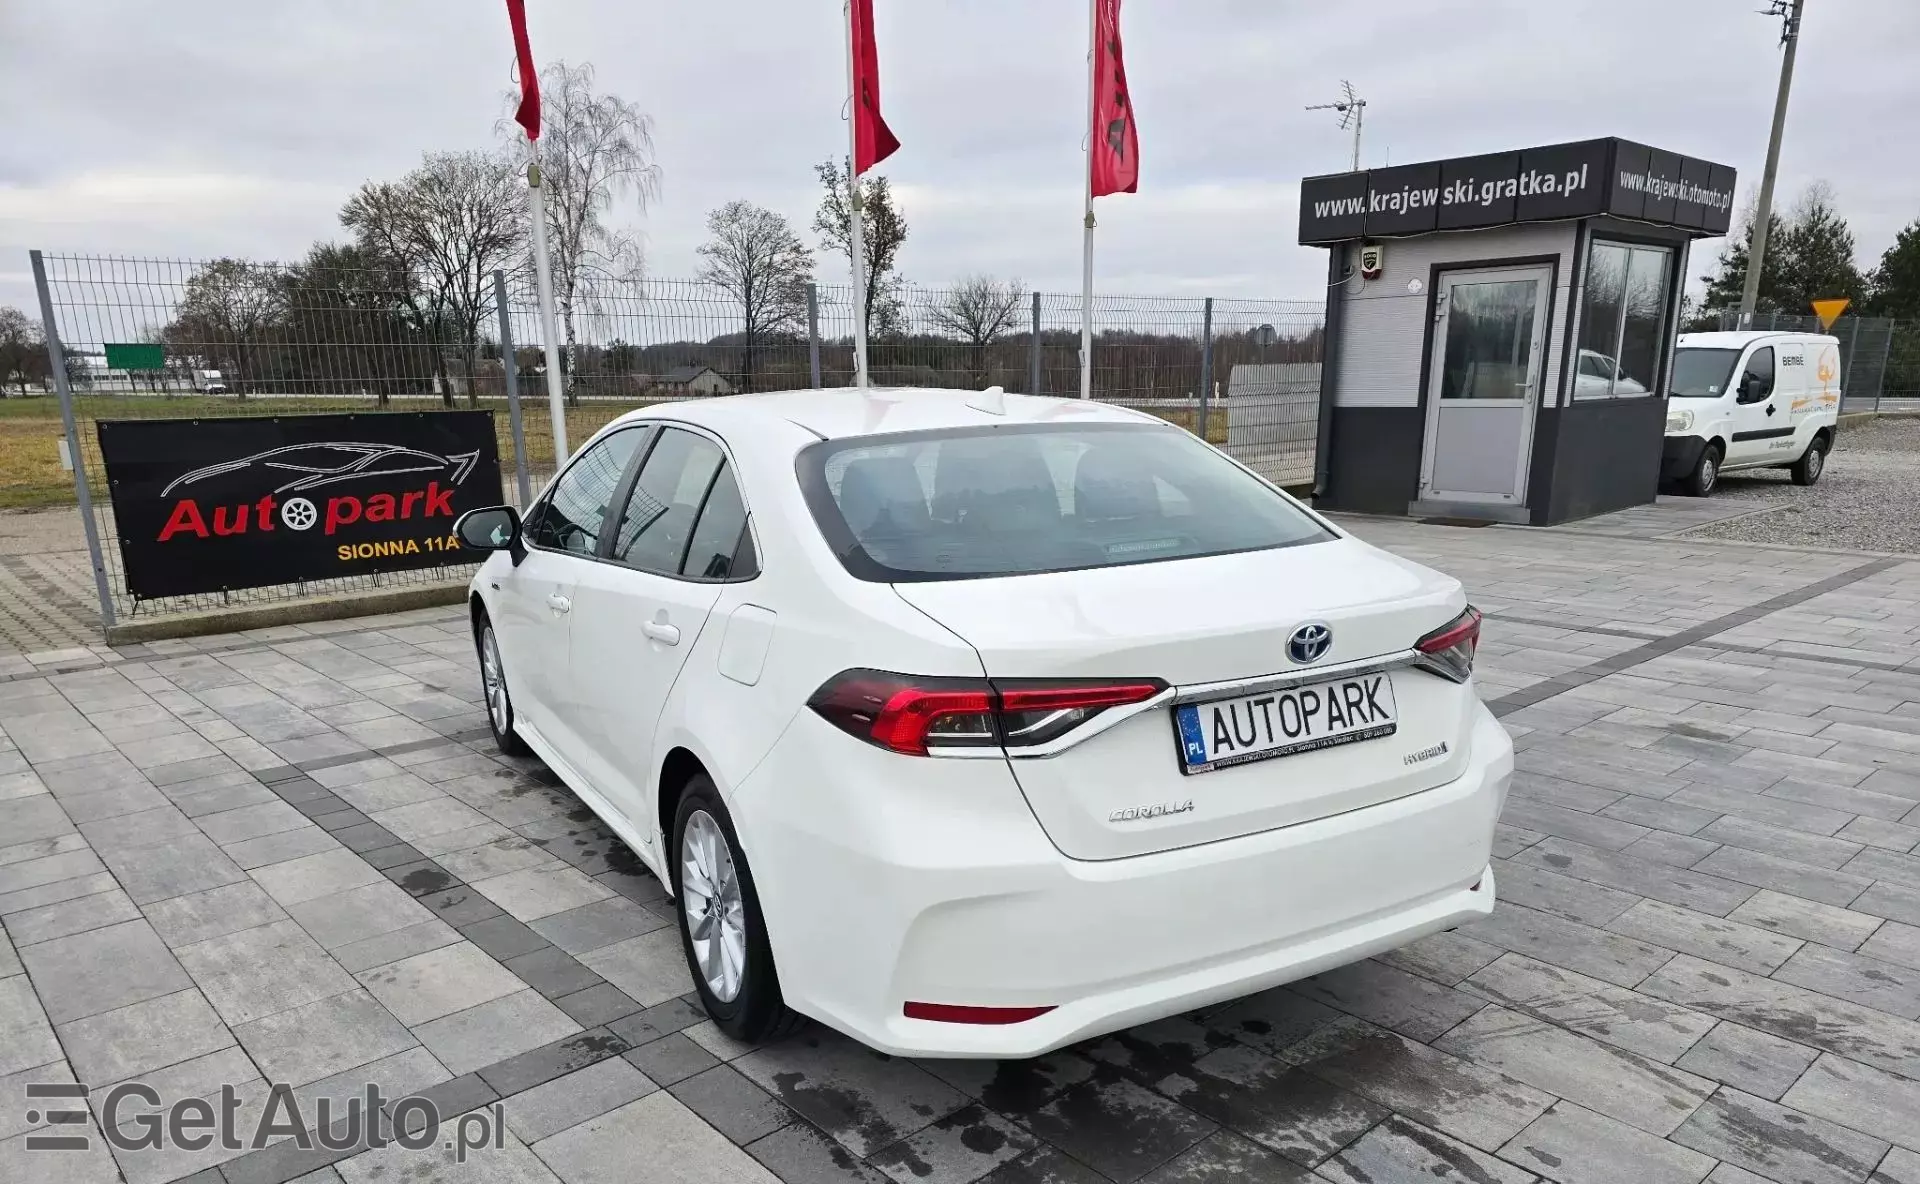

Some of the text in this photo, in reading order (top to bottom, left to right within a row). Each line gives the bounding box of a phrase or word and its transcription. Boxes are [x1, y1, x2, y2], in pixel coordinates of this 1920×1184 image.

[1620, 169, 1732, 214] www.krajewski.otomoto.pl
[337, 535, 460, 561] SIONNA 11A
[1213, 676, 1390, 755] AUTOPARK
[1188, 743, 1204, 756] PL
[1108, 799, 1195, 822] COROLLA
